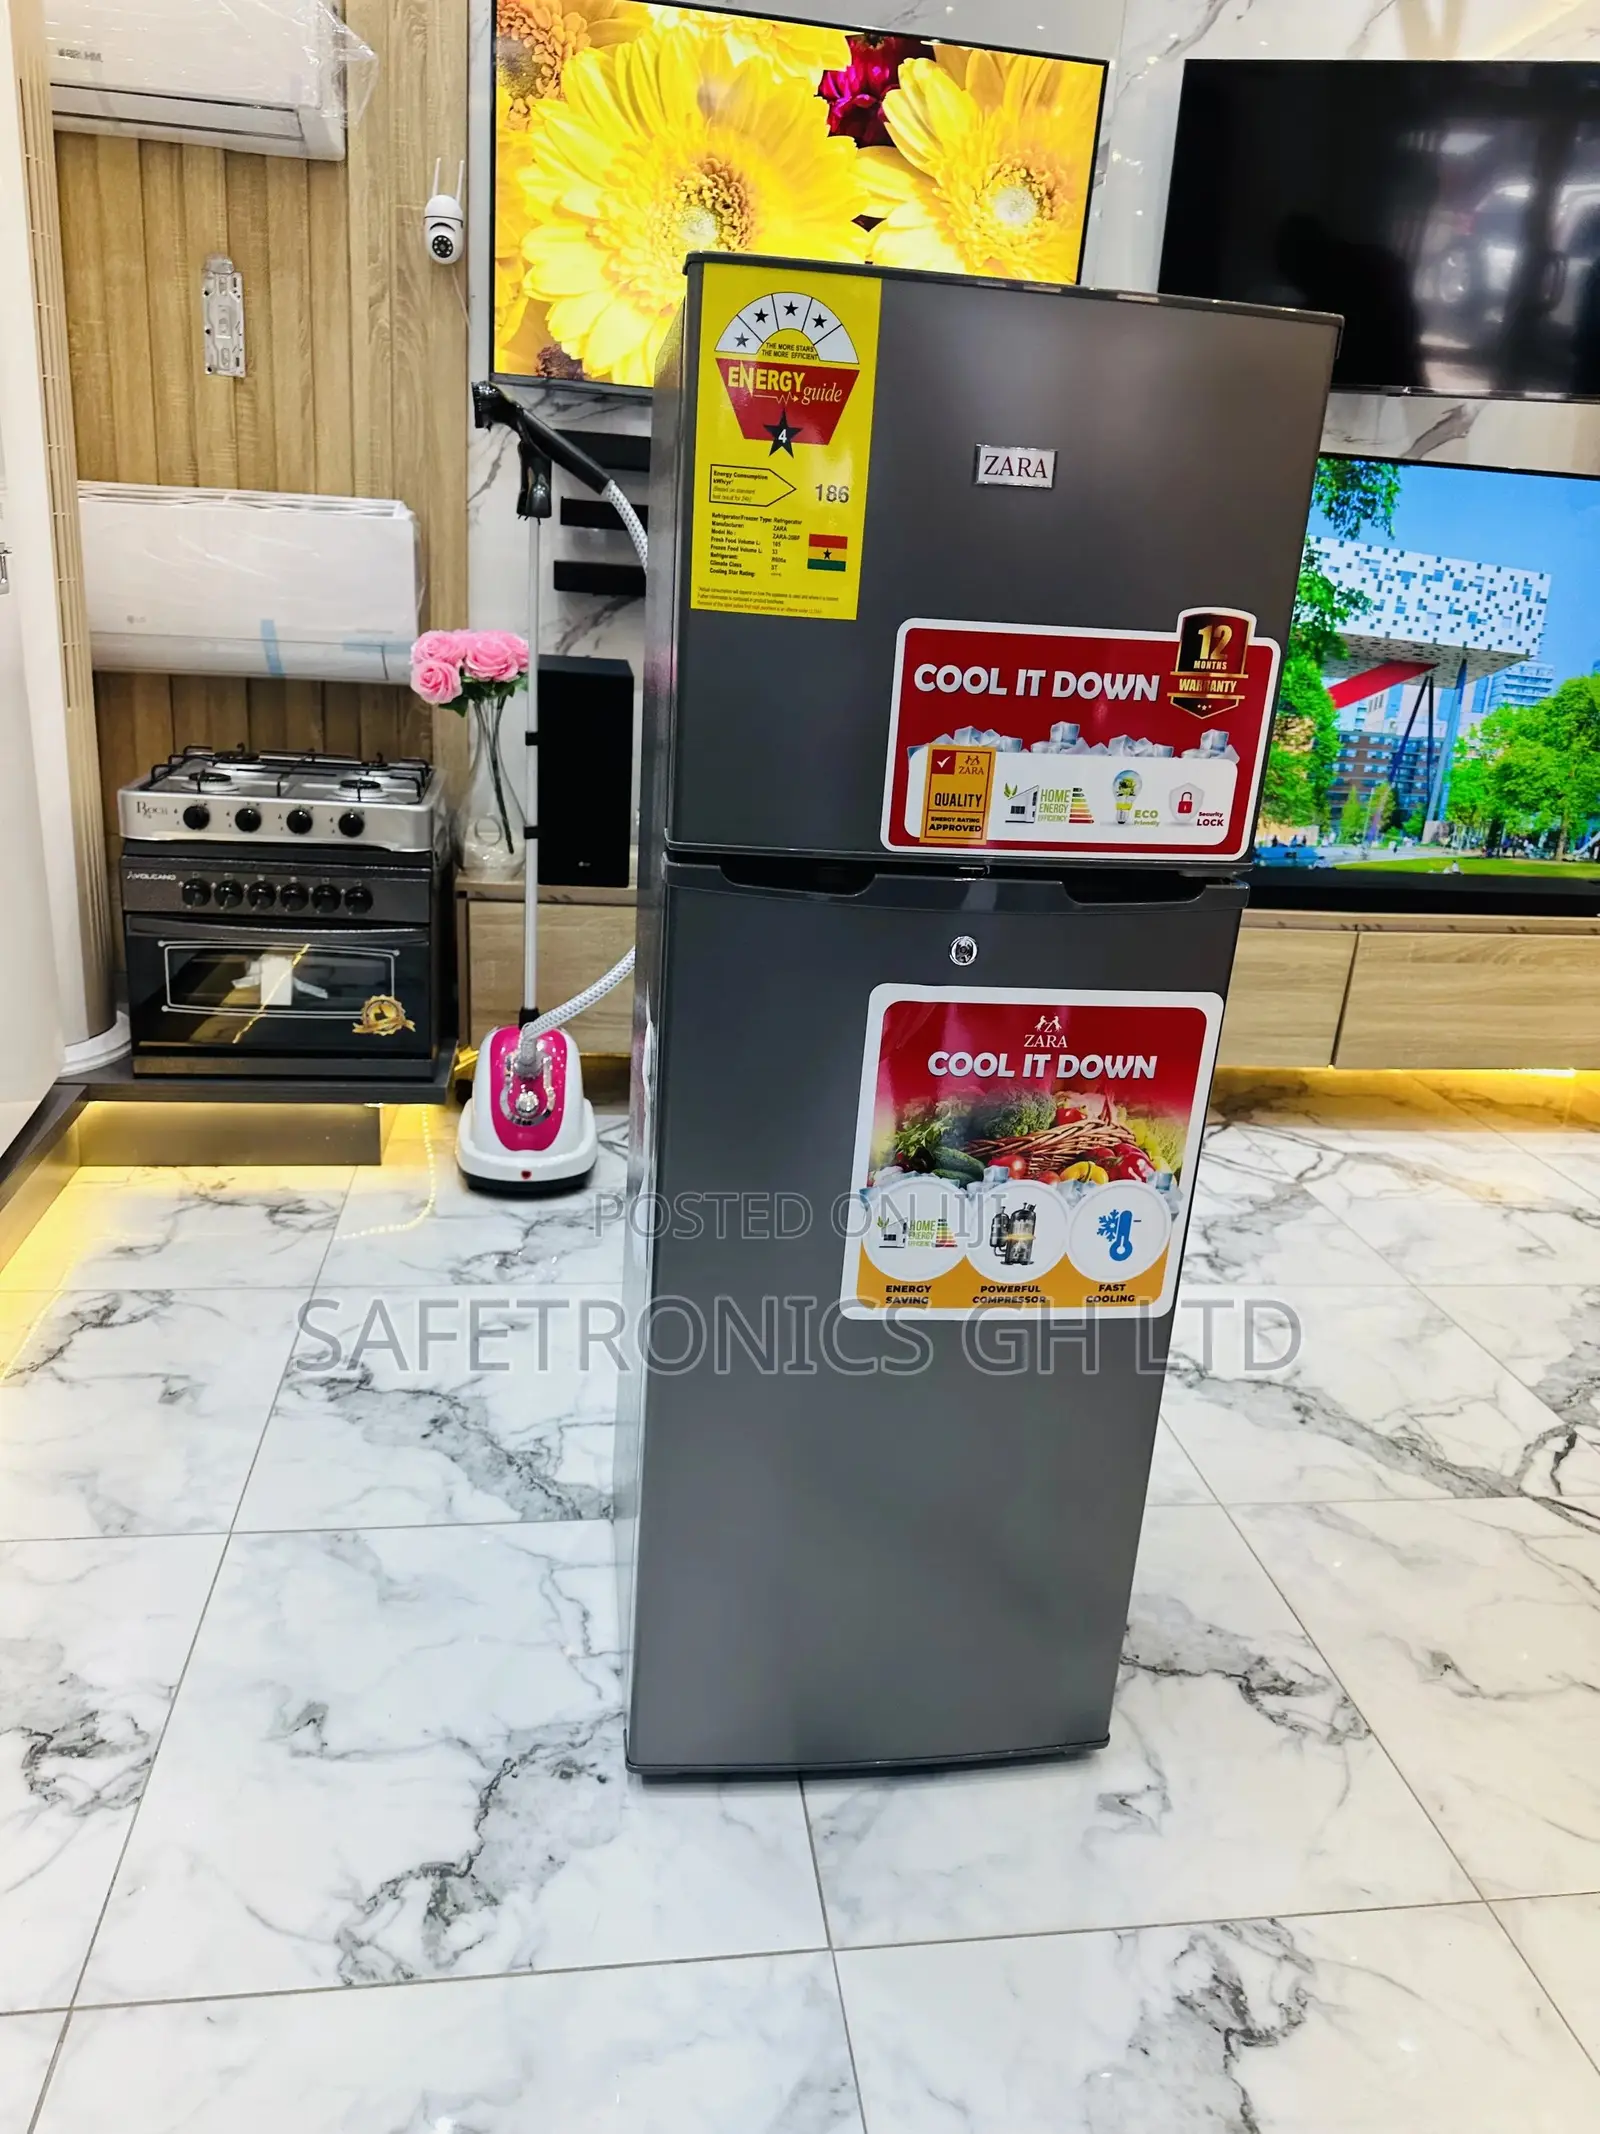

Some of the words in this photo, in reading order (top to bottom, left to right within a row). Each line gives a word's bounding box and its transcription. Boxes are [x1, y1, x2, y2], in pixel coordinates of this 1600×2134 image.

[765, 342, 776, 350] THE
[778, 343, 795, 351] MORE
[796, 344, 814, 352] STARS
[773, 350, 788, 358] MORE
[791, 352, 818, 360] EFFICIENT
[727, 361, 805, 397] ENERGY
[801, 382, 843, 405] guide
[778, 429, 788, 444] 4
[984, 455, 1048, 479] ZARA
[713, 470, 732, 478] Energy
[733, 472, 768, 480] Consumption
[815, 484, 850, 504] 186
[1197, 624, 1233, 660] 12
[1193, 660, 1228, 670] MONTHS
[914, 663, 1008, 696] COOL
[1016, 668, 1047, 697] IT
[1052, 670, 1160, 702] DOWN
[1178, 678, 1238, 693] WARRANTY
[958, 766, 984, 776] ZARA
[934, 792, 982, 808] QUALITY
[1040, 788, 1071, 803] HOME
[1039, 803, 1069, 814] ENERGY
[1134, 810, 1158, 819] ECO
[1196, 818, 1224, 827] LOCK
[928, 824, 982, 832] APPROVED
[1023, 1034, 1068, 1048] ZARA
[927, 1050, 1016, 1078] COOL
[1022, 1053, 1051, 1078] IT
[1056, 1054, 1158, 1079] DOWN
[910, 1220, 936, 1232] HOME
[885, 1285, 932, 1293] ENERGY
[980, 1285, 1041, 1293] POWERFUL
[1098, 1284, 1126, 1292] FAST
[886, 1296, 929, 1305] SAVING
[972, 1296, 1047, 1304] COMPRESSOR
[1085, 1295, 1136, 1303] COOLING
